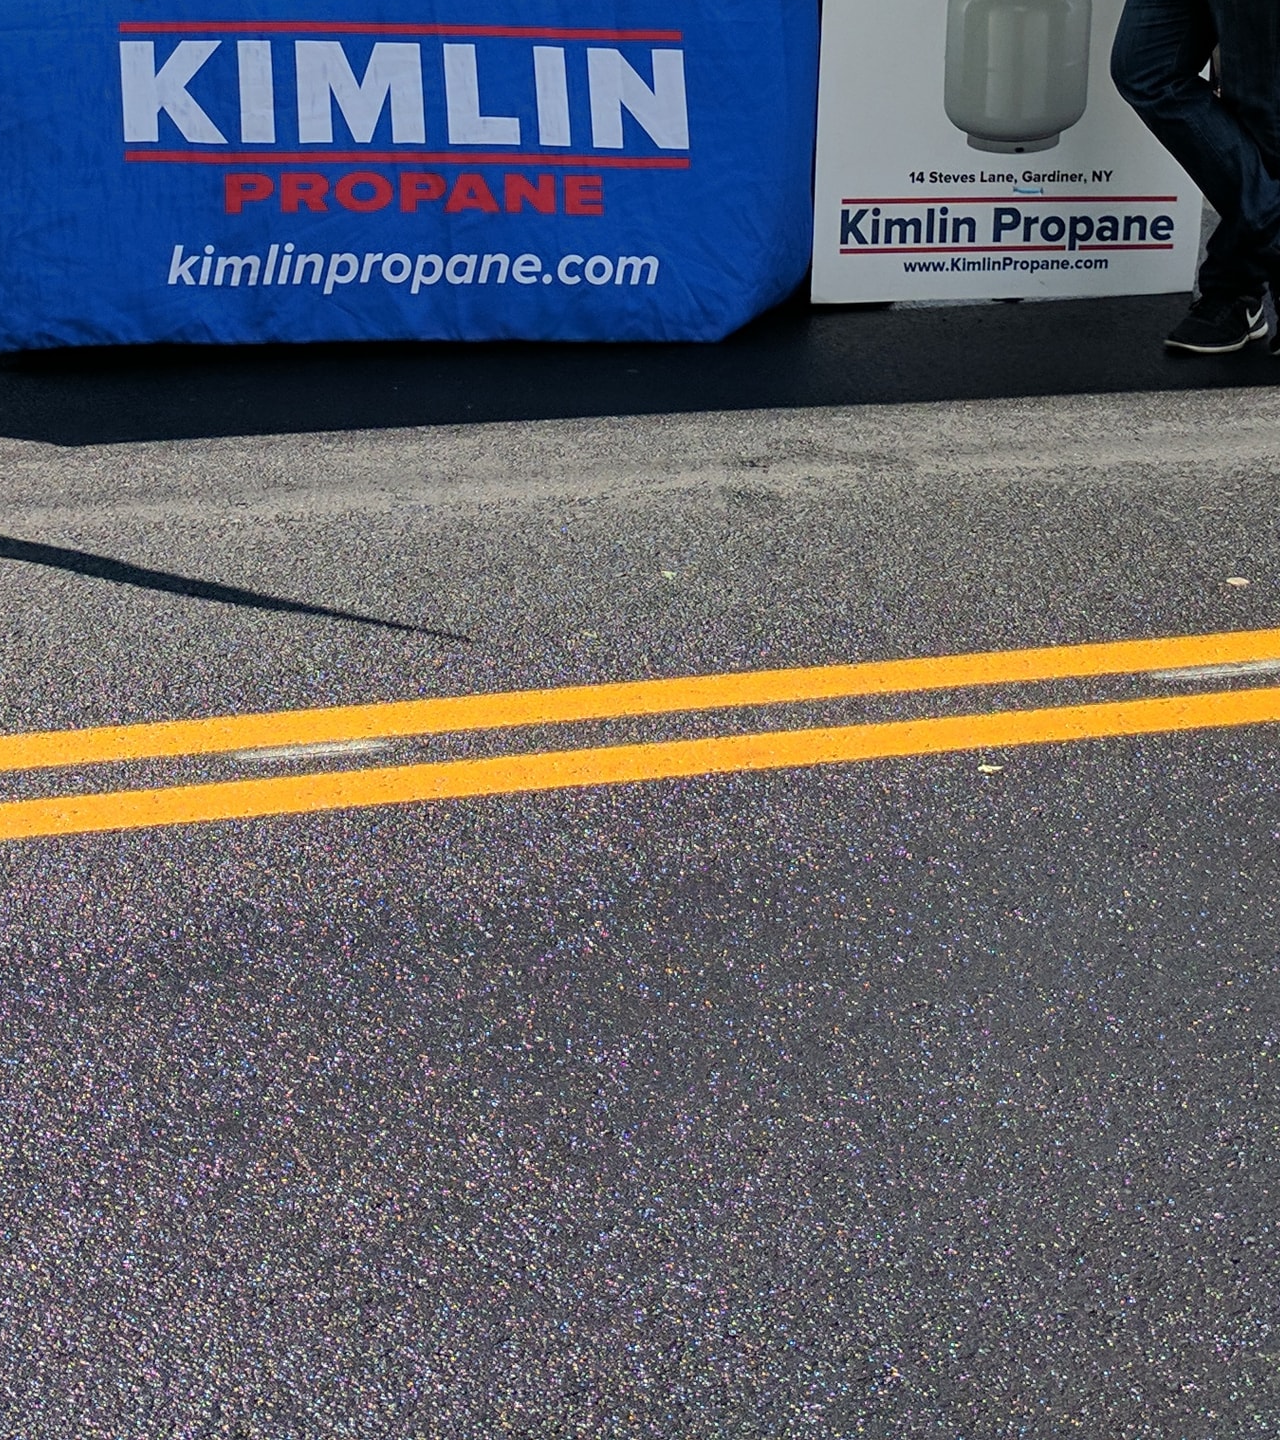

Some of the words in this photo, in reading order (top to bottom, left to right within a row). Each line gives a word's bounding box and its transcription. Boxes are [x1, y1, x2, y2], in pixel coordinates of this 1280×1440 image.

[120, 40, 690, 150] KIMLIN
[225, 171, 605, 216] PROPANE
[909, 171, 925, 184] 14
[928, 171, 976, 184] Steves
[979, 171, 1018, 186] Lane,
[1021, 170, 1088, 186] Gardiner,
[1091, 170, 1113, 183] NY
[840, 206, 976, 245] Kimlin
[992, 207, 1174, 251] Propane
[168, 242, 660, 295] kimlinpropane.com
[903, 256, 1109, 274] www.KimlinPropane.com
